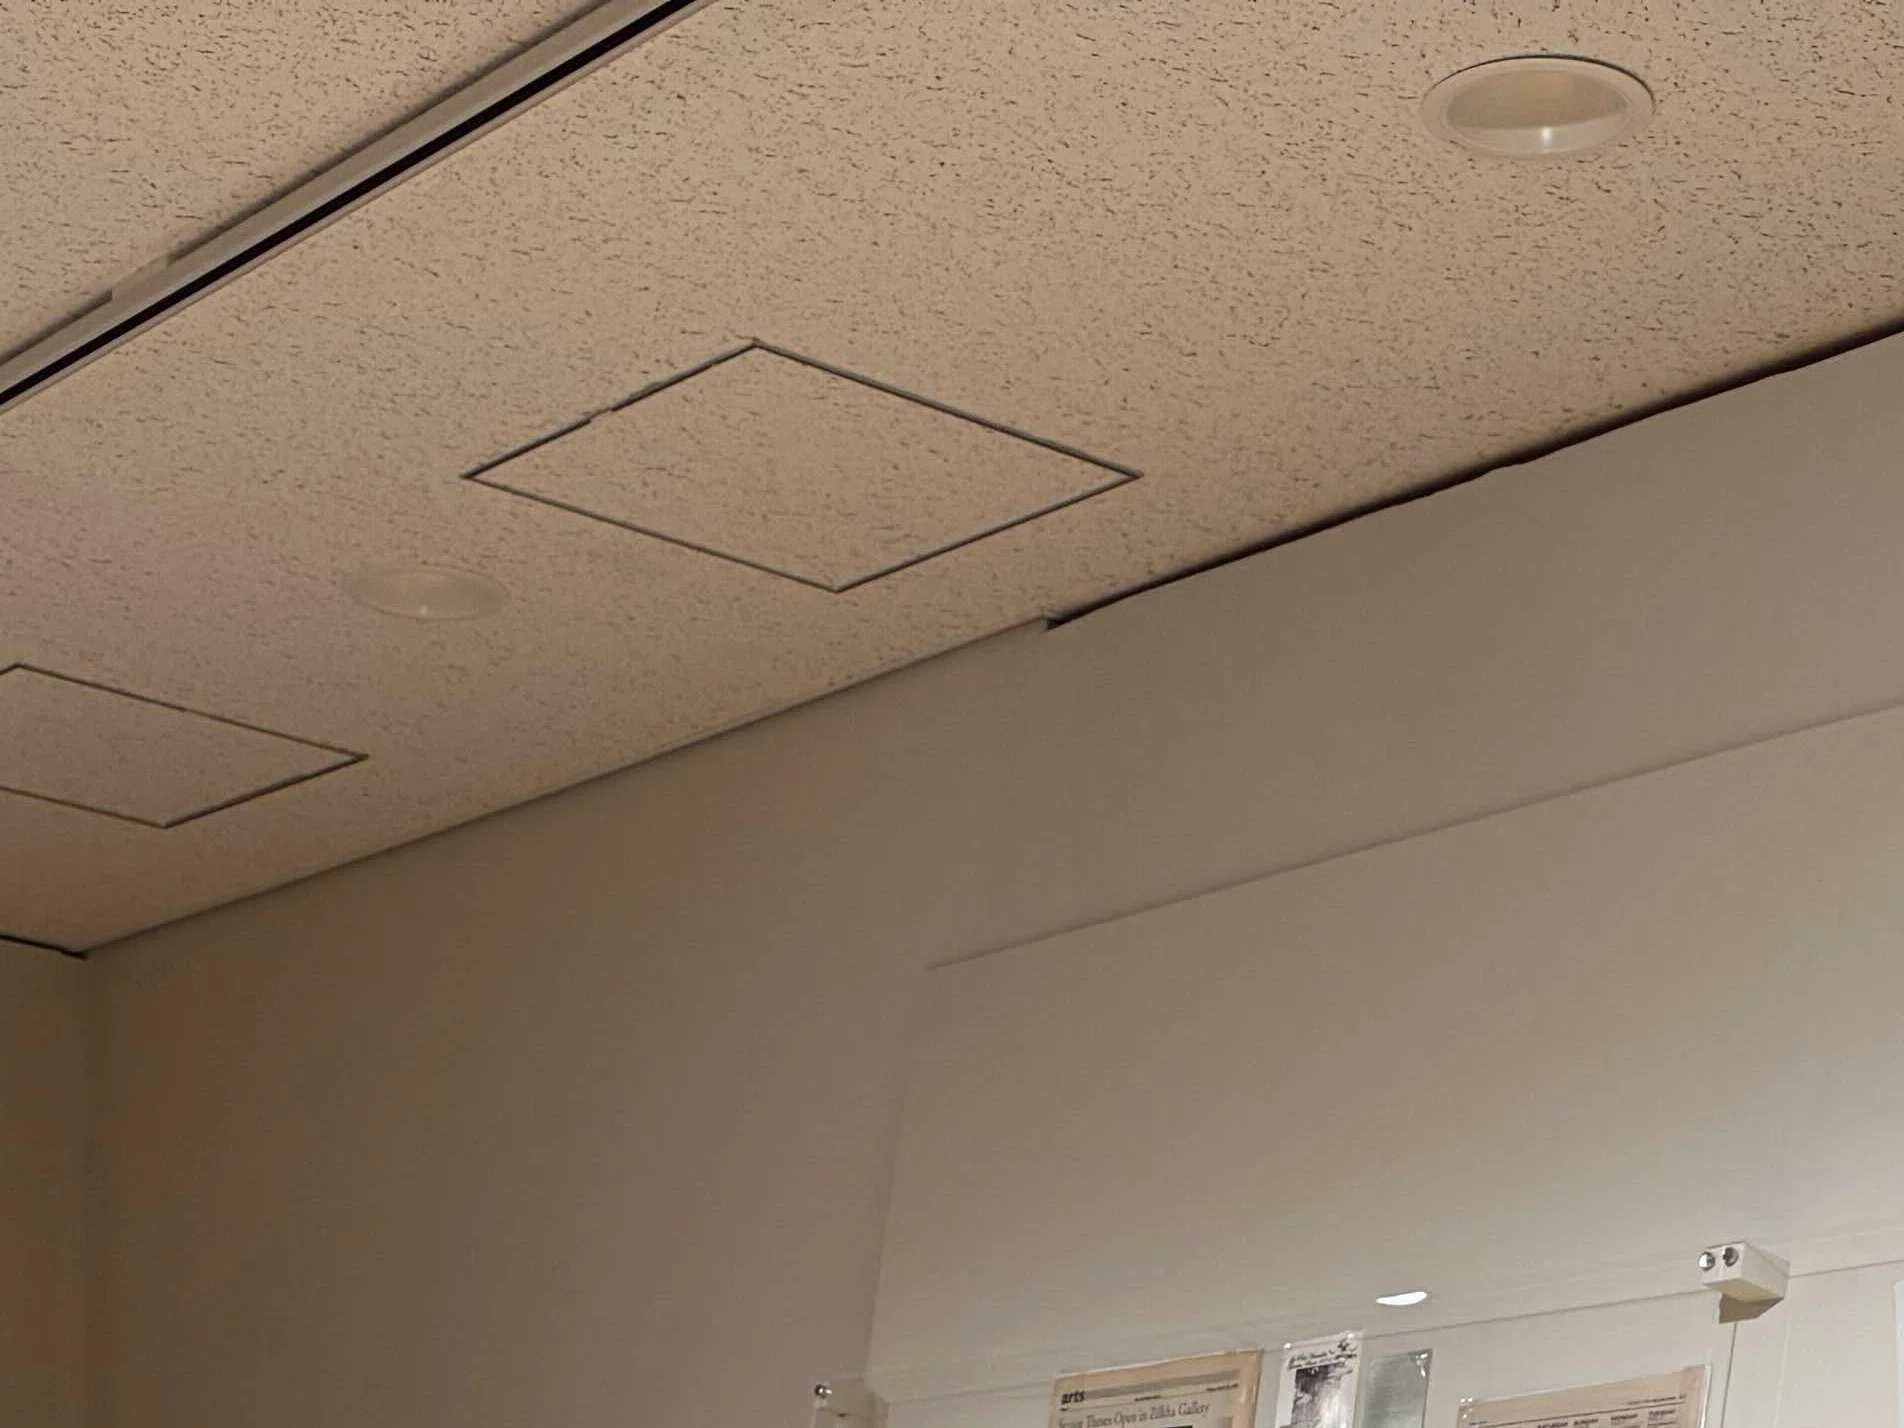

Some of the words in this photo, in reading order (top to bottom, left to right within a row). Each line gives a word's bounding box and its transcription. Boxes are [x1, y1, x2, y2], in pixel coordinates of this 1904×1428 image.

[1060, 1390, 1086, 1405] arts
[1113, 1411, 1137, 1428] Open
[1178, 1402, 1210, 1418] Gallery
